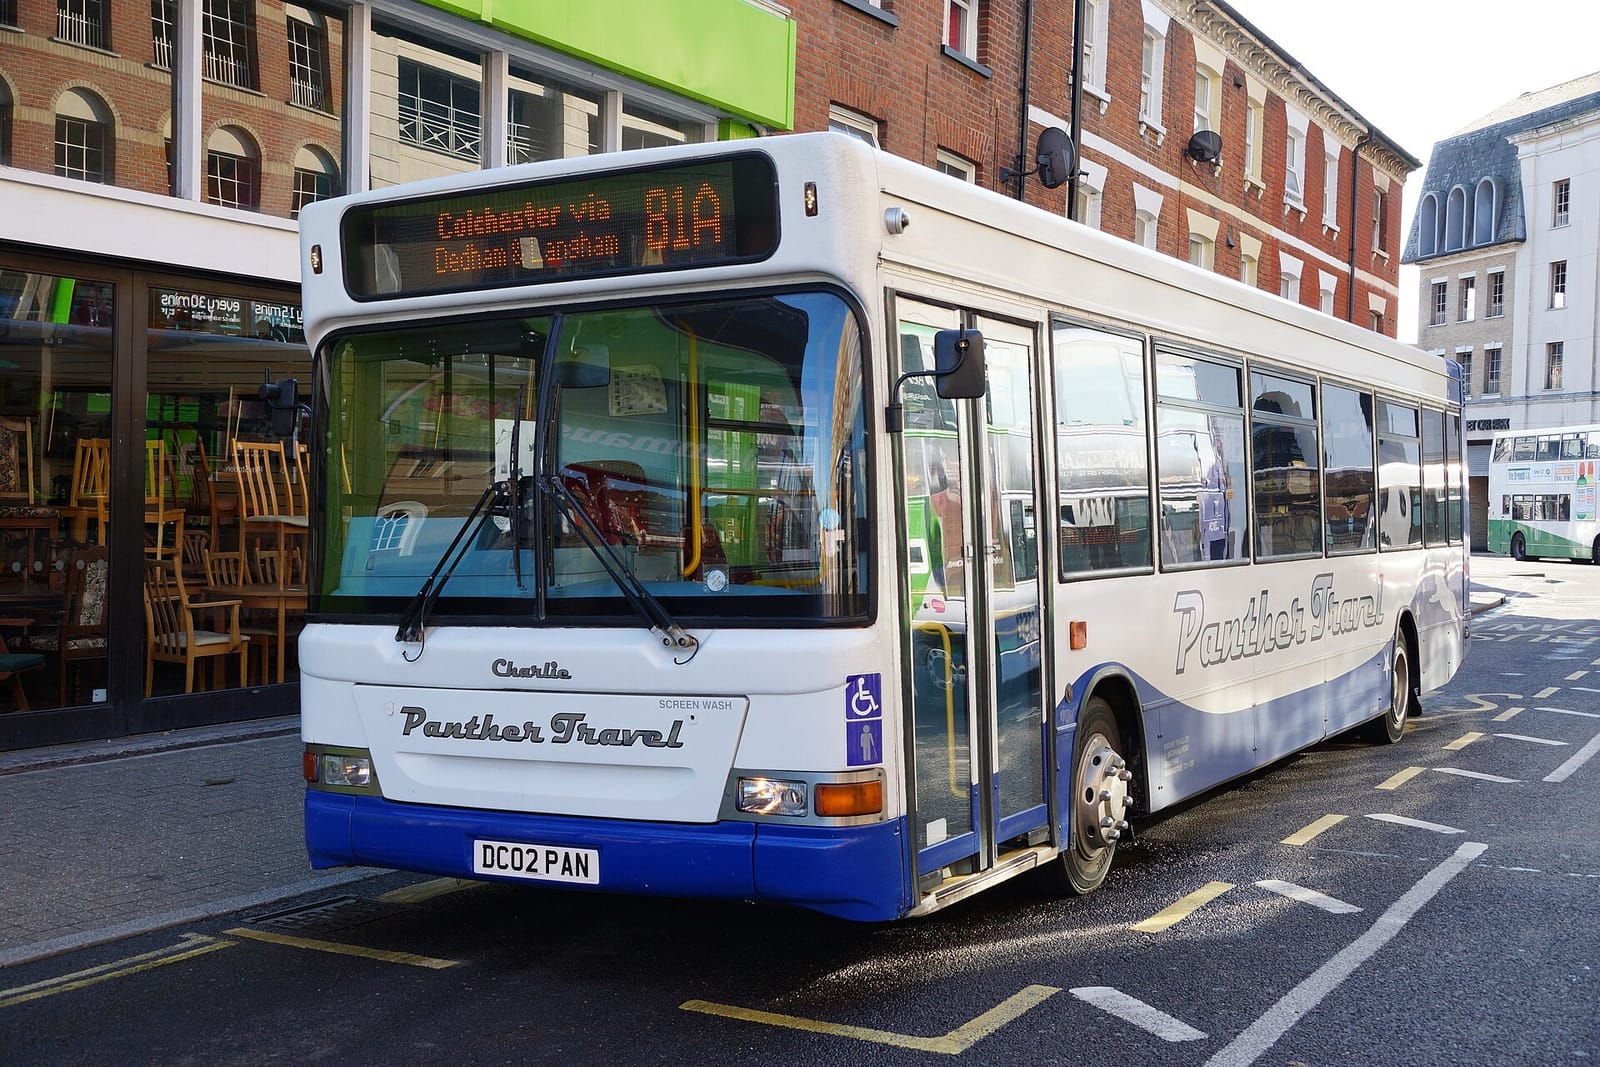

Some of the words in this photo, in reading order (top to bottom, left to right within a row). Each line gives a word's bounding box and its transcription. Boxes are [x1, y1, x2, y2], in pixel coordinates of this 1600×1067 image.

[438, 202, 561, 239] Colchester
[569, 193, 610, 223] via
[646, 182, 722, 251] 81A
[434, 243, 507, 274] Dedham
[1173, 590, 1306, 675] Panther
[1311, 573, 1385, 642] Travel
[491, 659, 572, 680] Charlie
[659, 699, 701, 710] SCREEN
[703, 699, 733, 712] WASH
[401, 707, 545, 743] Panther
[550, 713, 684, 749] Travel
[482, 844, 539, 872] DC02
[544, 849, 589, 878] PAN
